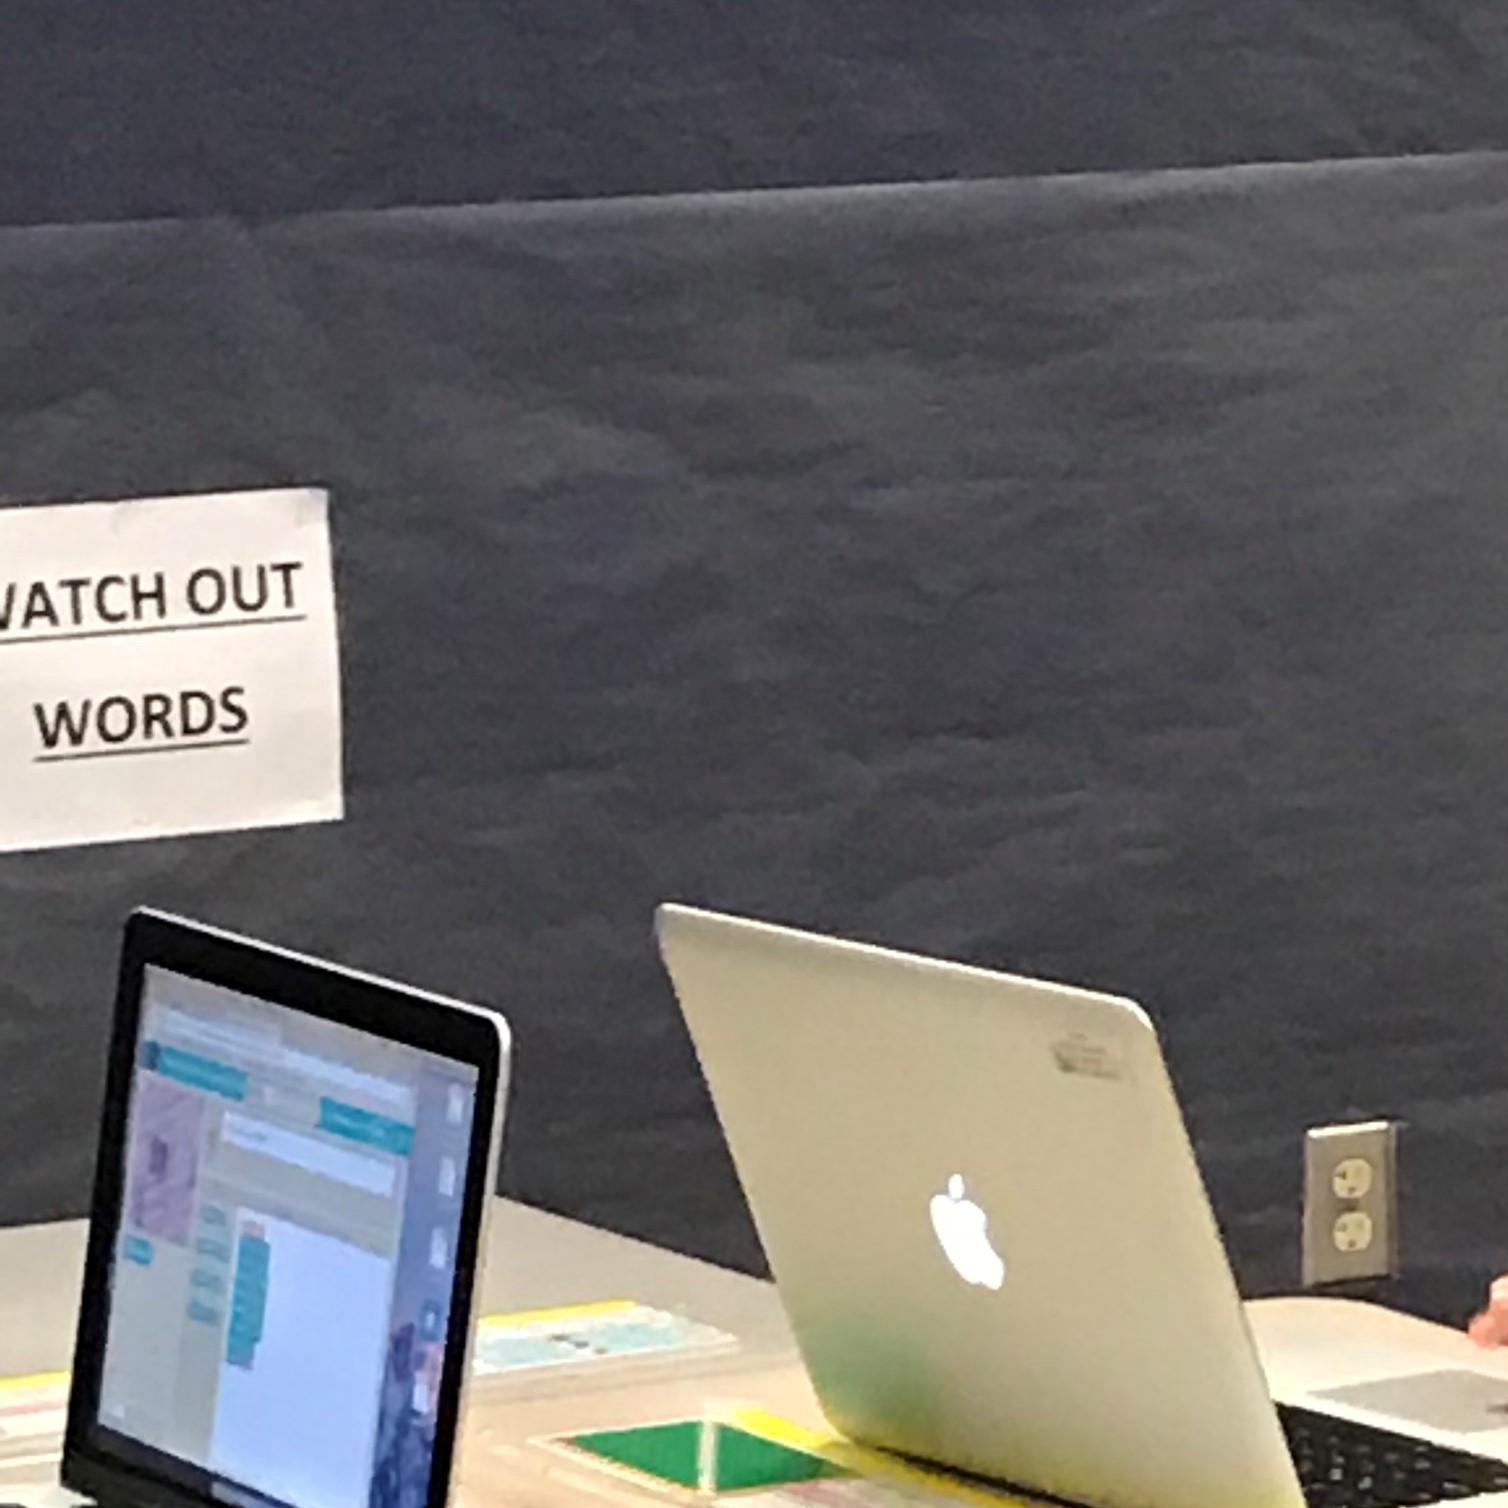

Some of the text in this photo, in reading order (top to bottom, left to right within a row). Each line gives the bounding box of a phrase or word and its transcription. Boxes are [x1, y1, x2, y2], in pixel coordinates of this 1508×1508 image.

[0, 561, 303, 630] ATCH OUT
[33, 685, 249, 749] WORDS
